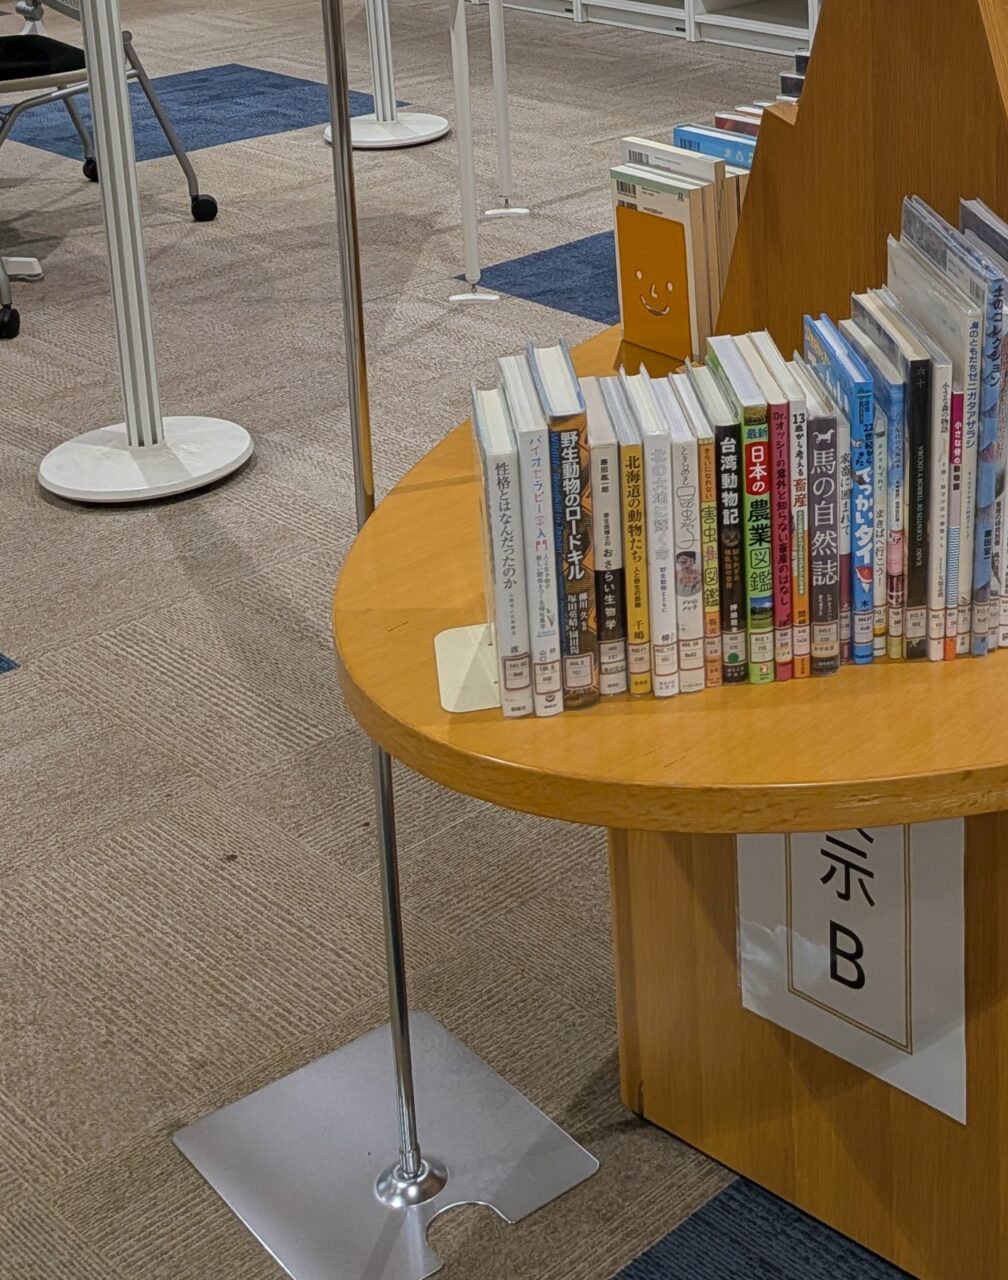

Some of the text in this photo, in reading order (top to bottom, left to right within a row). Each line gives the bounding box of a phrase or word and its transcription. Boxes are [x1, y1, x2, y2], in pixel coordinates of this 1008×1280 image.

[720, 437, 740, 525] 台湾動物記
[747, 429, 768, 440] 最新
[749, 445, 768, 492] 日本の
[495, 461, 518, 591] 性格とはなんだったのか
[529, 436, 549, 552] バイオセラピー学入門
[560, 431, 585, 581] 野生動物のロードキル
[625, 455, 644, 562] 北海道の動物たち
[747, 499, 771, 593] 農業図鑑
[811, 450, 838, 587] 馬の自然誌
